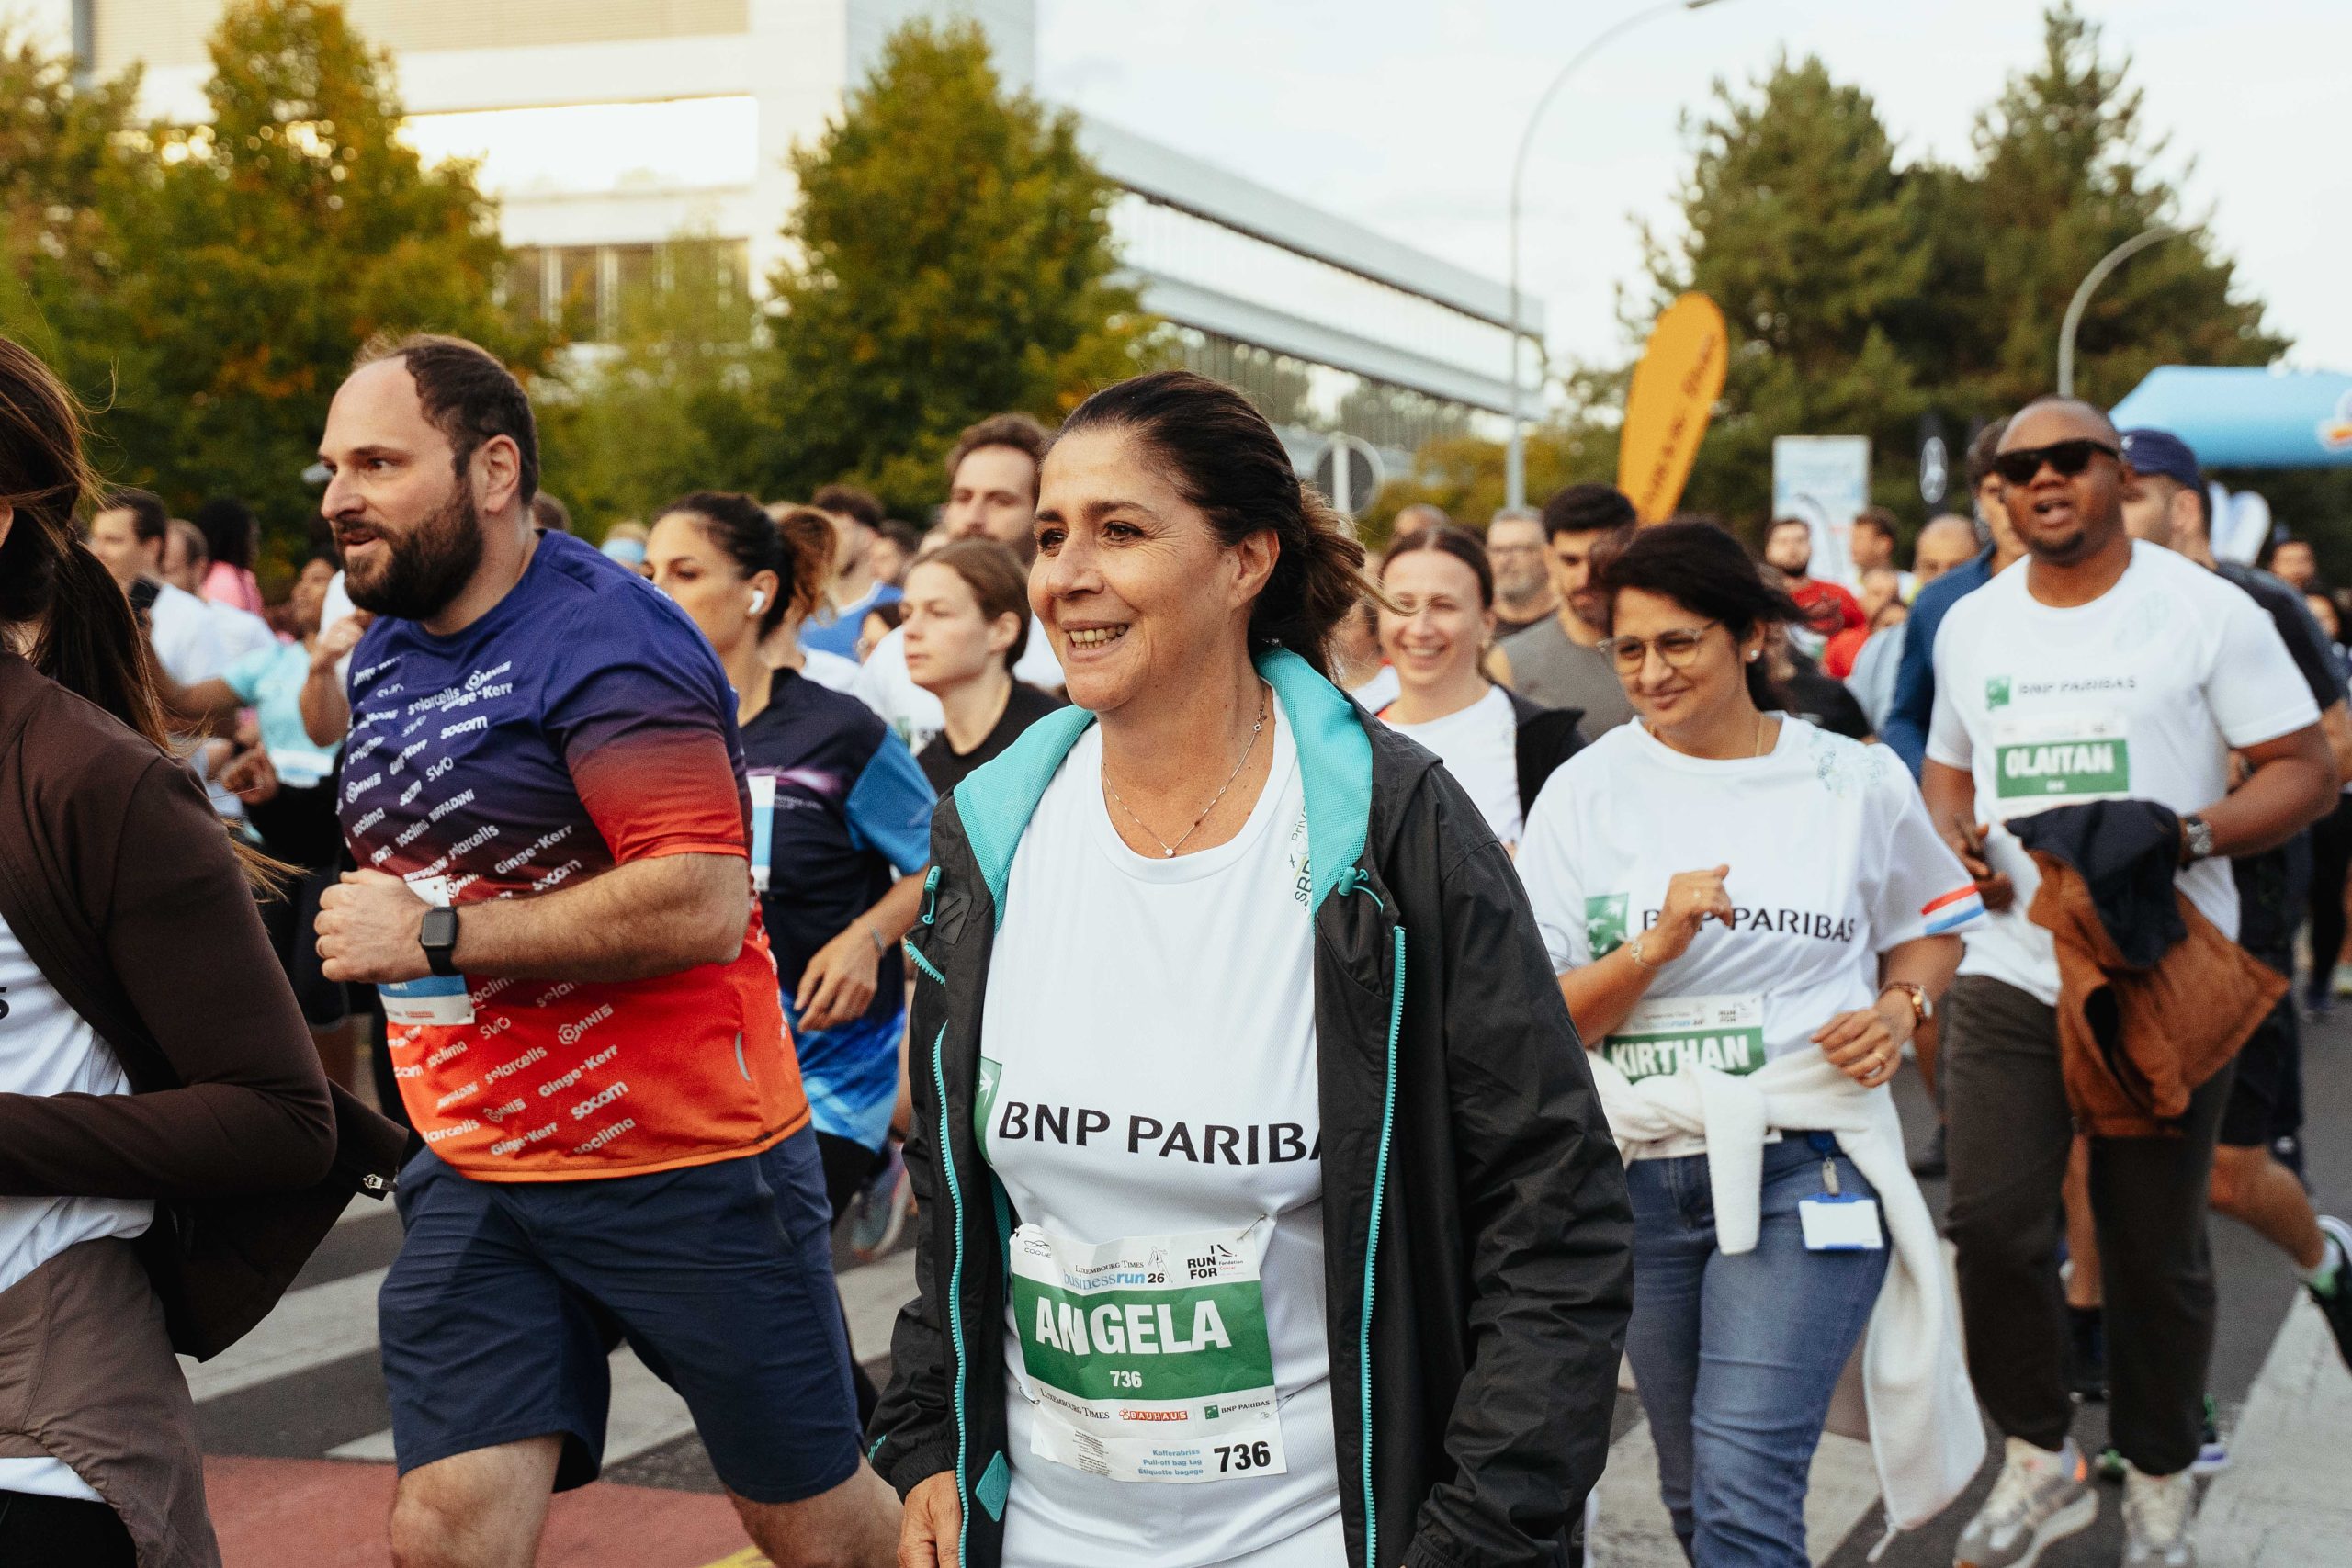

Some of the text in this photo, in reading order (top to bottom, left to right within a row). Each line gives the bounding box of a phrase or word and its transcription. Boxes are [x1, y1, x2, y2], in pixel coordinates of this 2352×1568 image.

[440, 716, 489, 739] socom
[2004, 743, 2115, 778] OLAITAN
[1731, 907, 1855, 942] PARIBAS
[1610, 1034, 1750, 1079] KIRTHAN
[570, 1081, 629, 1121] socom
[998, 1101, 1111, 1146] BNP
[573, 1117, 636, 1154] soclima
[1187, 1256, 1216, 1269] RUN
[1190, 1267, 1218, 1280] FOR
[1148, 1273, 1165, 1284] 26
[1035, 1295, 1232, 1356] ANGELA
[1109, 1370, 1142, 1388] 736
[1130, 1410, 1188, 1421] BAUHAUS
[1221, 1400, 1271, 1414] BNP PARIBAS
[1143, 1458, 1203, 1467] Pull-off bag tag
[1214, 1440, 1272, 1472] 736
[1174, 1468, 1204, 1477] bagage
